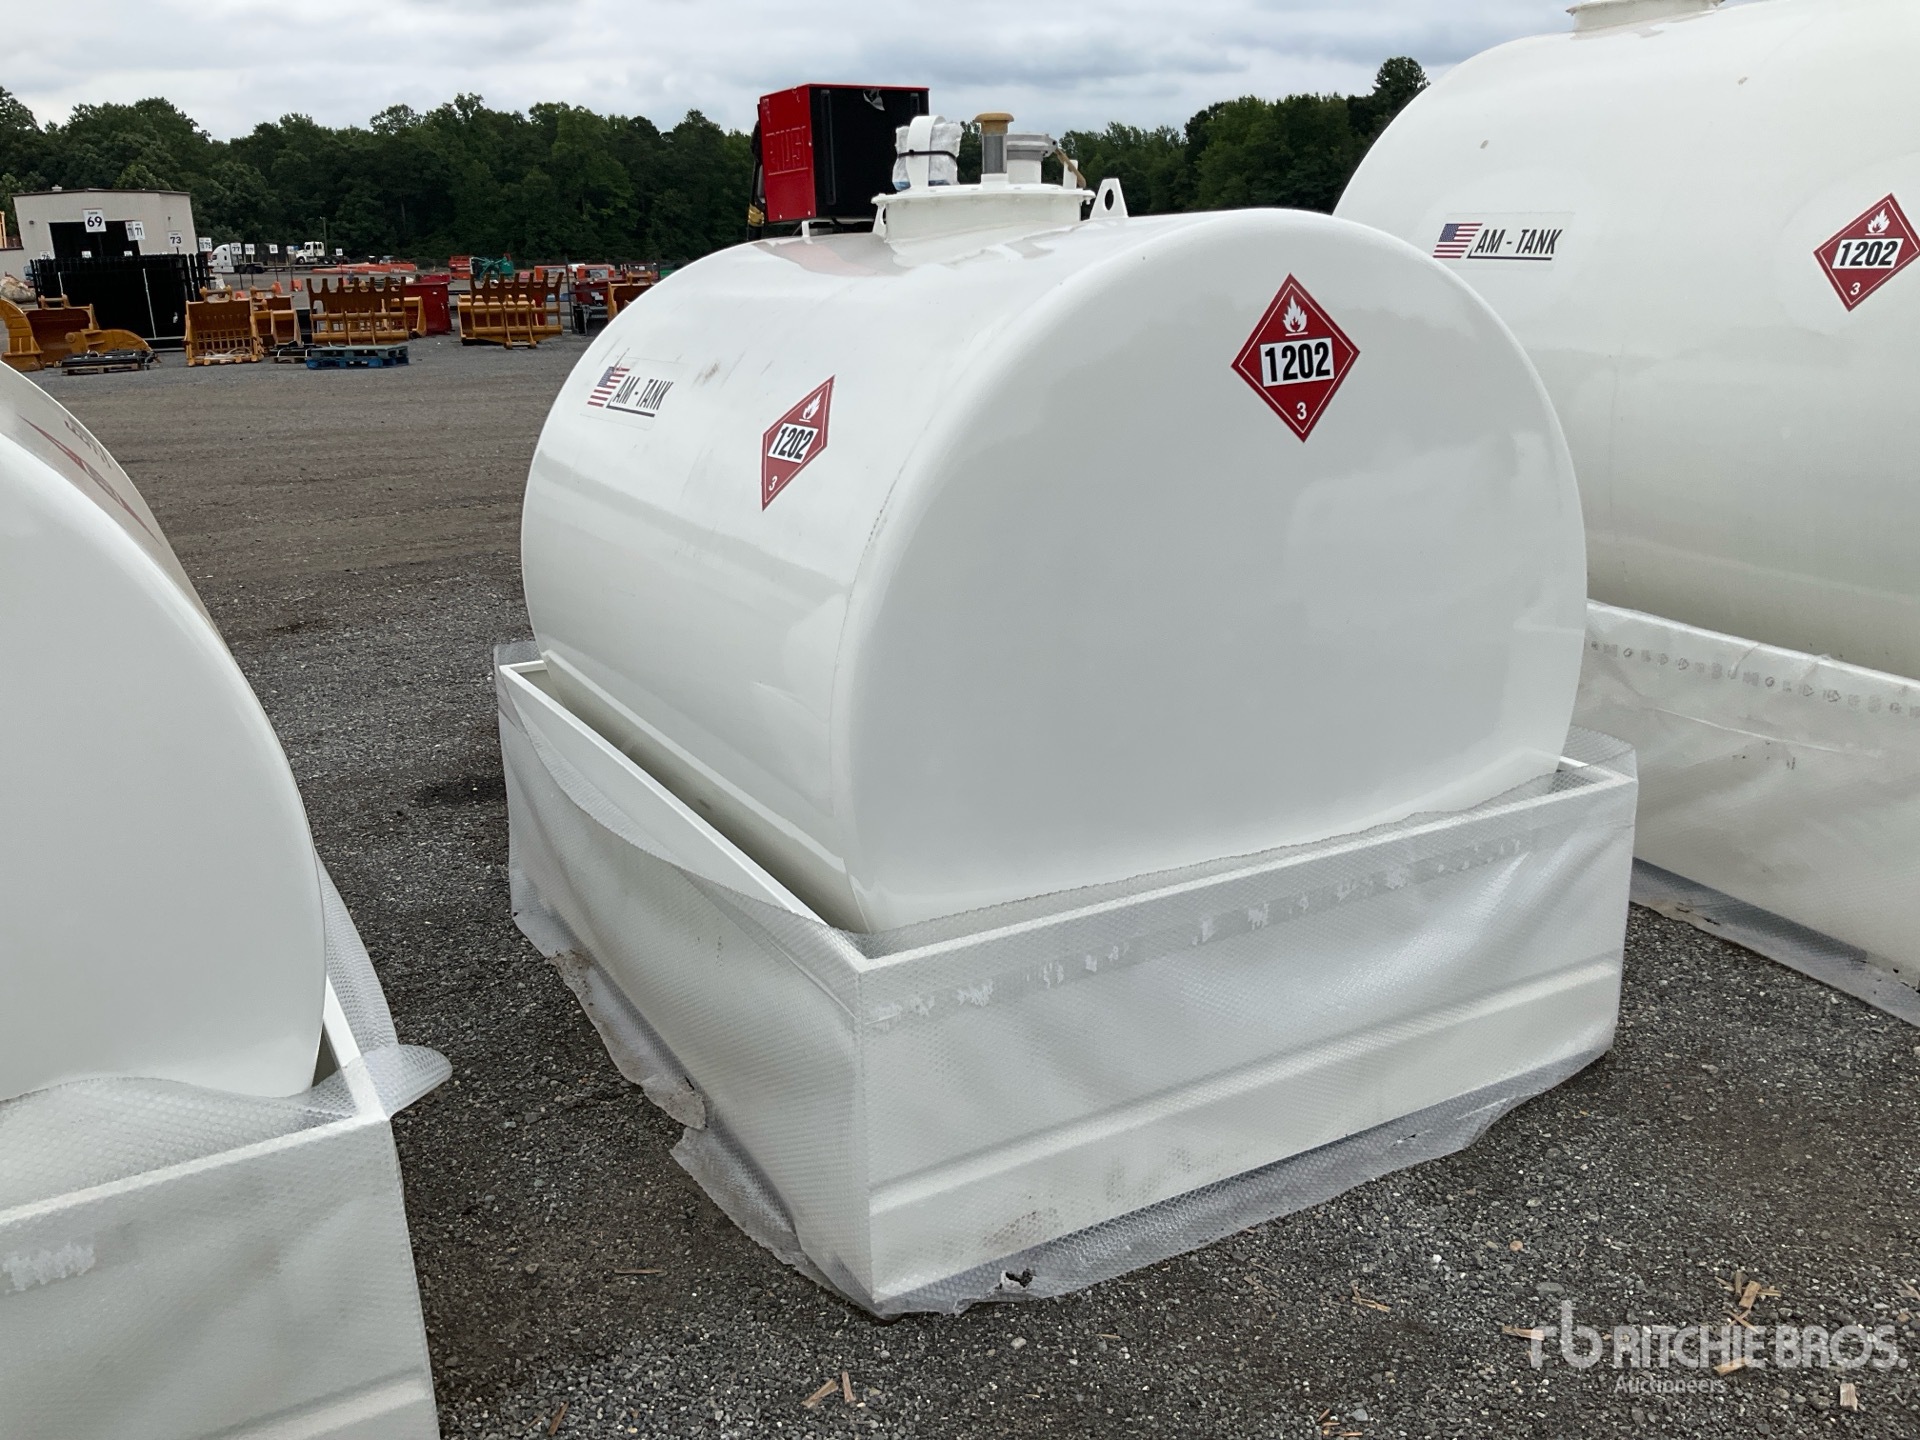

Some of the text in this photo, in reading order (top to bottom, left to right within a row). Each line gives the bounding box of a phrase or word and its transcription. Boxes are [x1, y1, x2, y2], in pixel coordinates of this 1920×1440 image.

[87, 216, 103, 227] 69
[134, 227, 143, 236] 71
[169, 236, 182, 244] 73
[1474, 229, 1506, 253] AM
[1515, 229, 1563, 254] TANK
[1839, 241, 1898, 266] 1202
[1850, 282, 1861, 295] 3
[1265, 342, 1330, 382] 1202
[612, 376, 640, 404] AM
[636, 379, 674, 410] TANK
[1296, 402, 1307, 420] 3
[772, 426, 814, 460] 1202
[768, 475, 778, 491] 3
